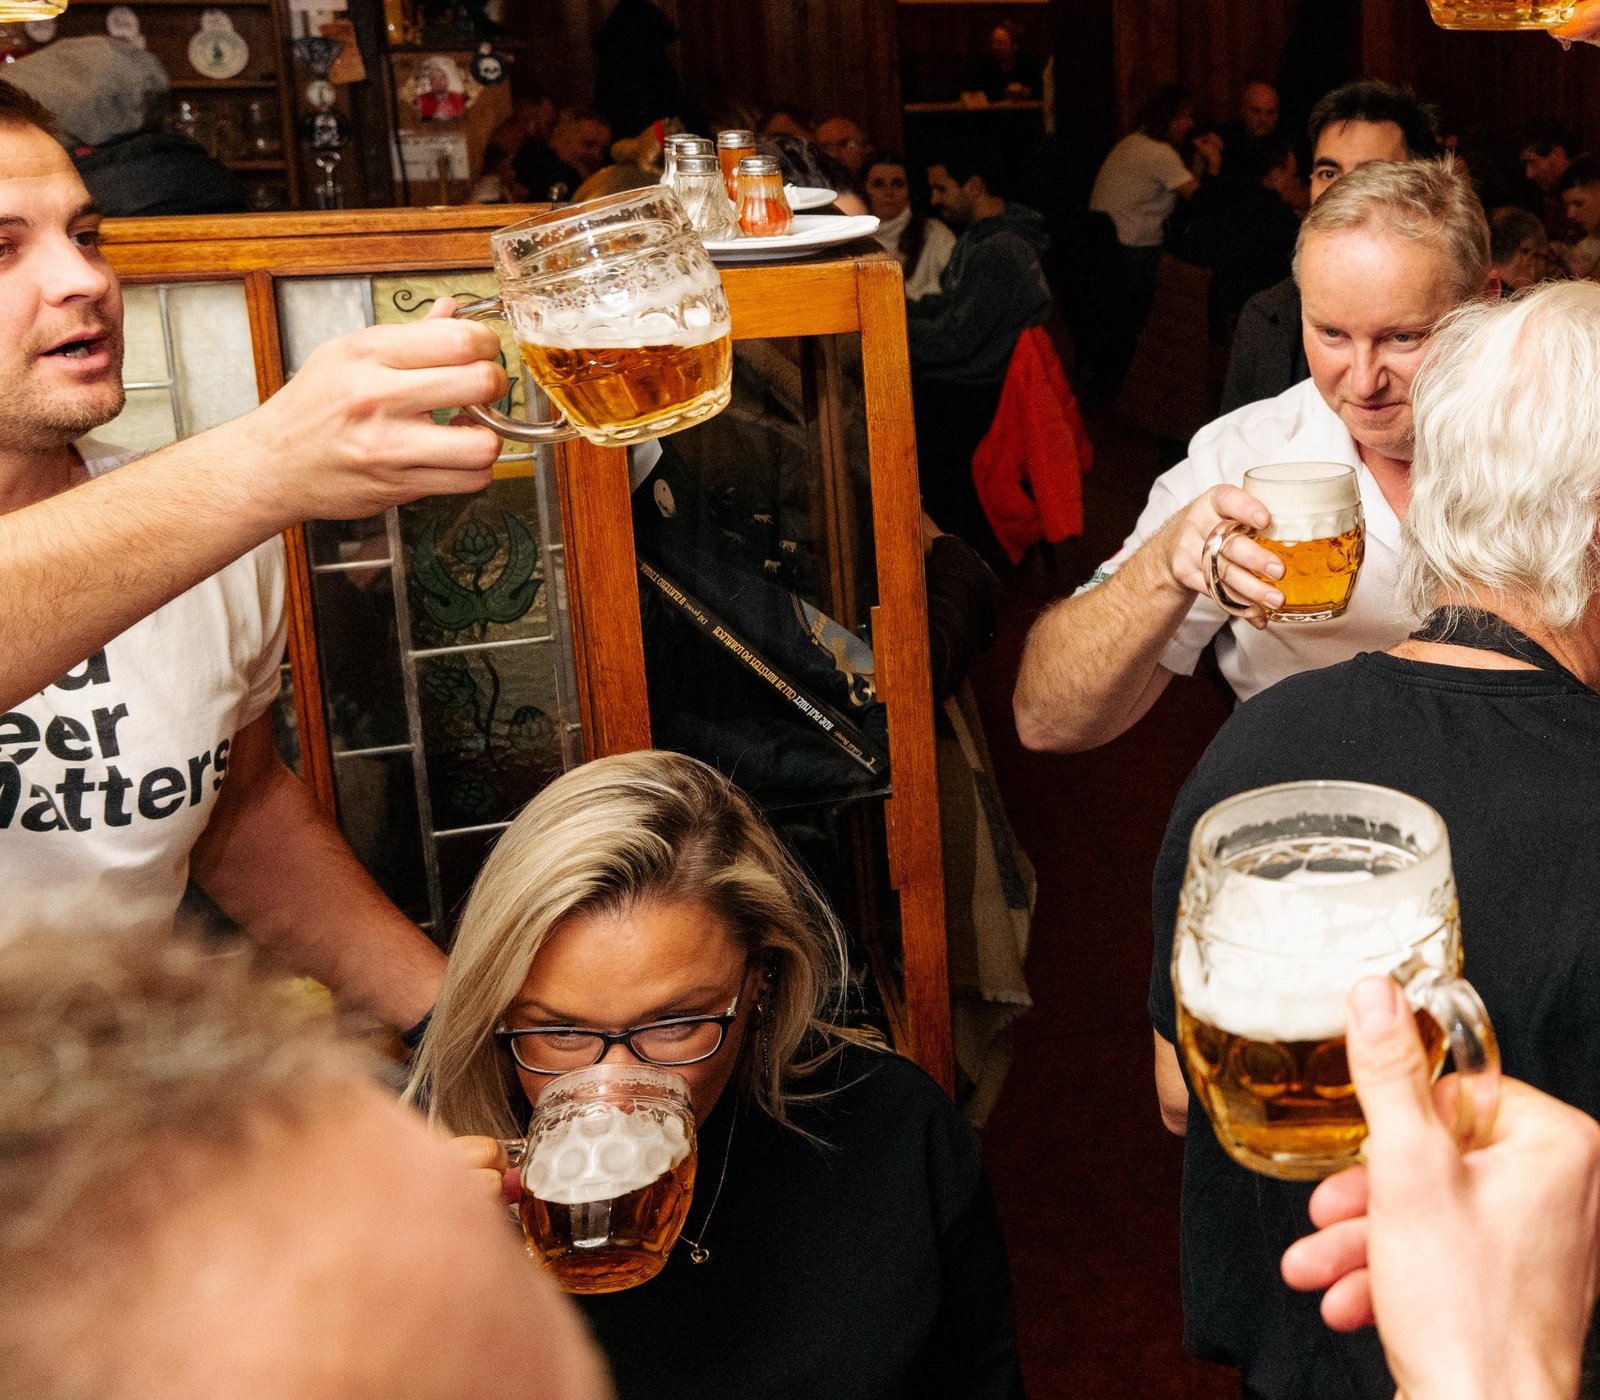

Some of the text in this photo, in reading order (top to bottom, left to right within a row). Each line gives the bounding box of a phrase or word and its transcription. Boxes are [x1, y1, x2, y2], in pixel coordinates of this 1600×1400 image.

[740, 650, 753, 662] PO
[774, 679, 786, 691] ZA
[818, 716, 834, 731] KDE
